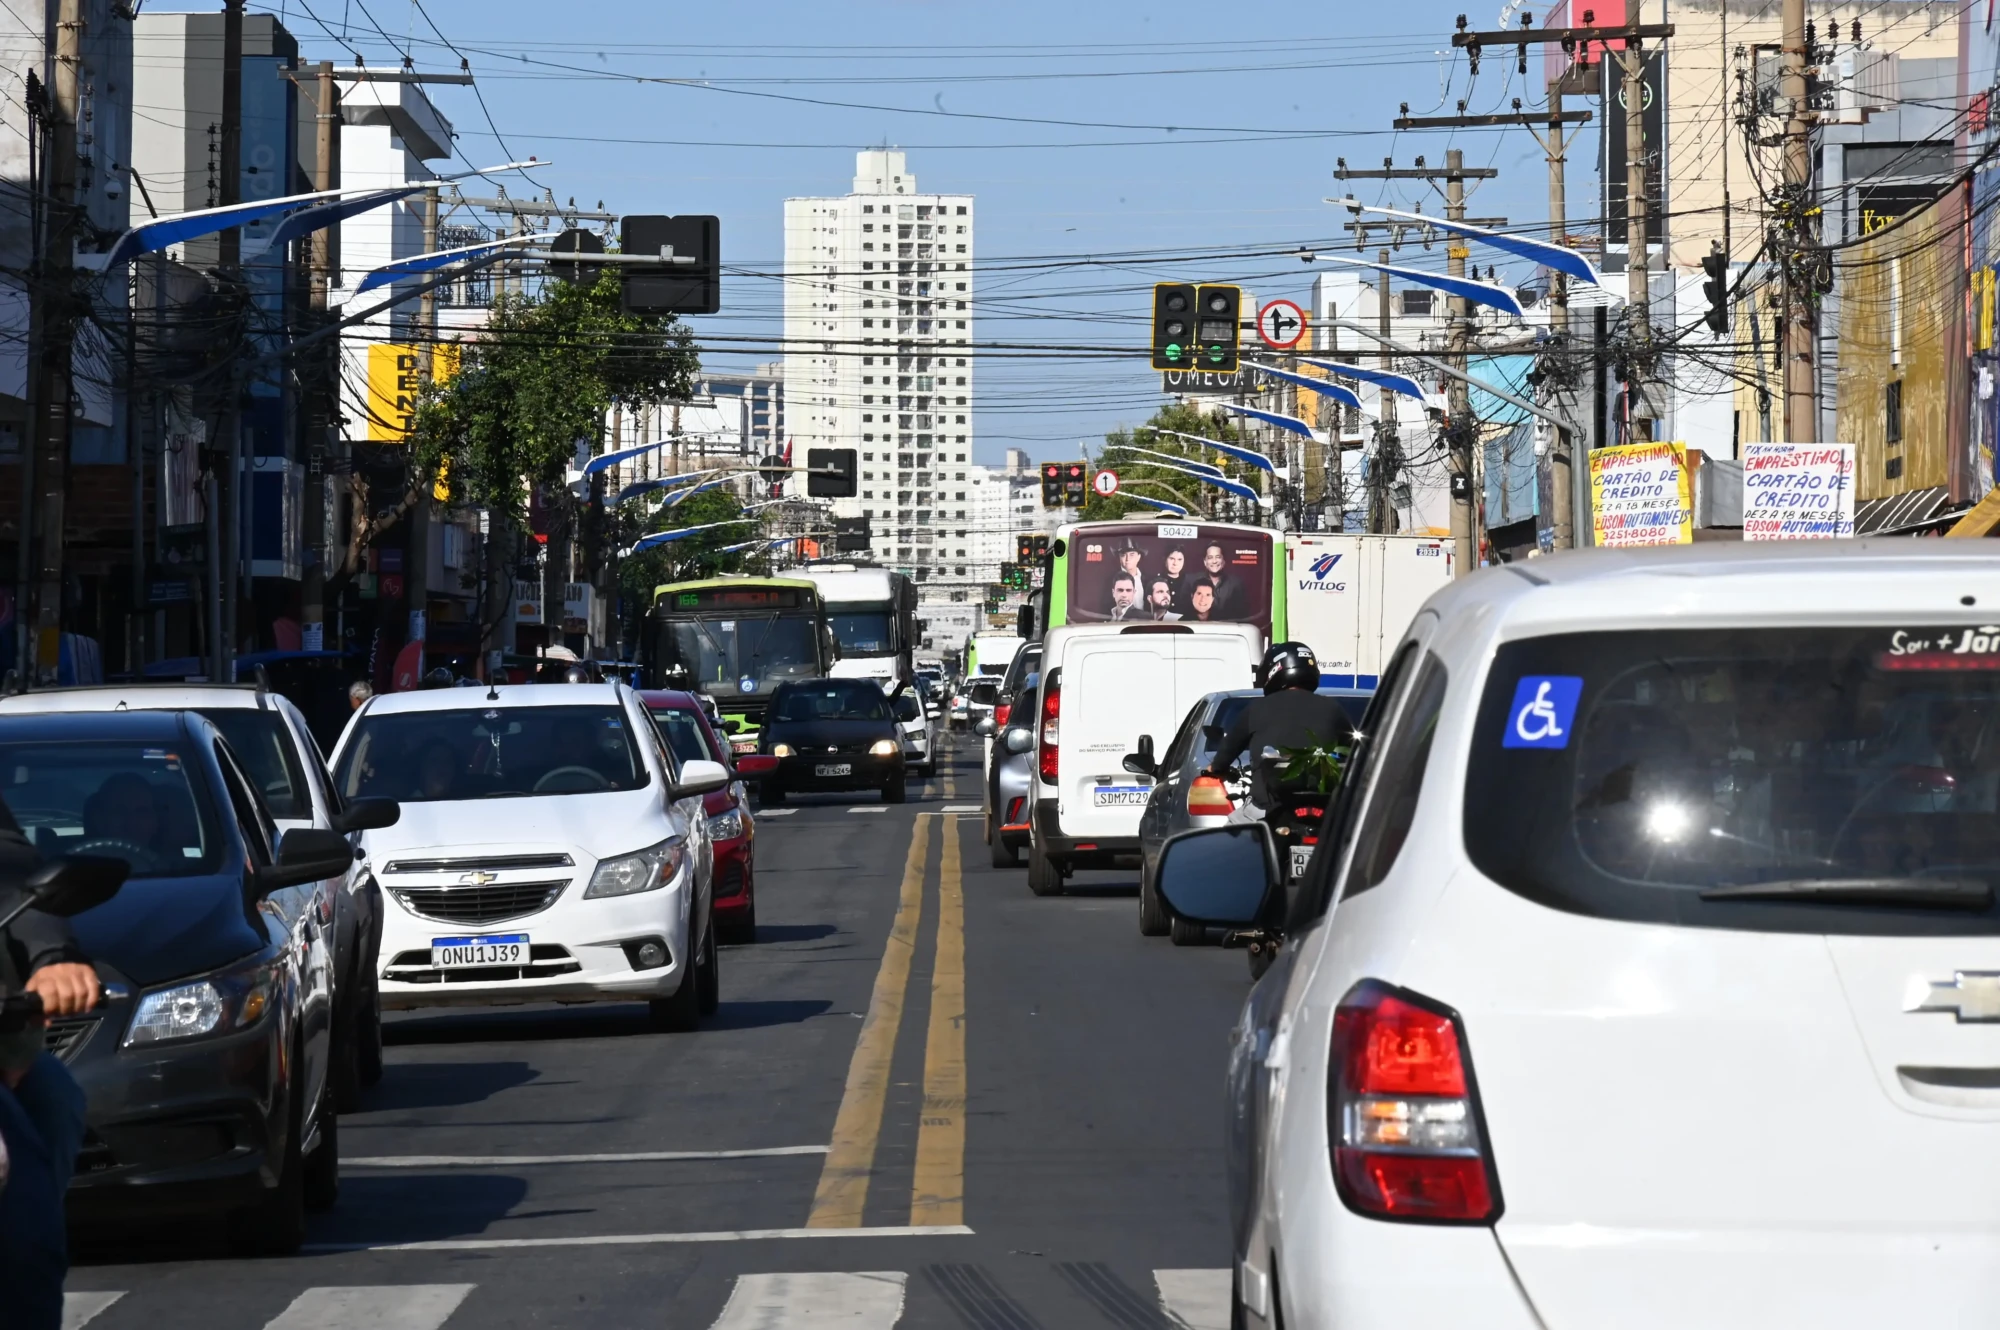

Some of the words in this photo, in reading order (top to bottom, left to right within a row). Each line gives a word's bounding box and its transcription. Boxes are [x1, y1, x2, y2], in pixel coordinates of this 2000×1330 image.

[1592, 445, 1669, 472] EMPRÉSTIMO
[1671, 452, 1684, 466] NO
[1593, 469, 1652, 486] CARTÃO
[1659, 470, 1680, 481] DE
[1746, 471, 1822, 489] CARTÃO
[1827, 475, 1850, 489] DE
[1601, 484, 1663, 499] CRÉDITO
[1626, 502, 1638, 510] 18
[1642, 500, 1680, 509] MESES
[1755, 489, 1830, 508] CRÉDITO
[1781, 510, 1795, 520] 18
[1799, 511, 1845, 521] MESES
[1163, 527, 1192, 537] 50422
[1299, 580, 1346, 591] VITLOG
[679, 594, 699, 605] 166
